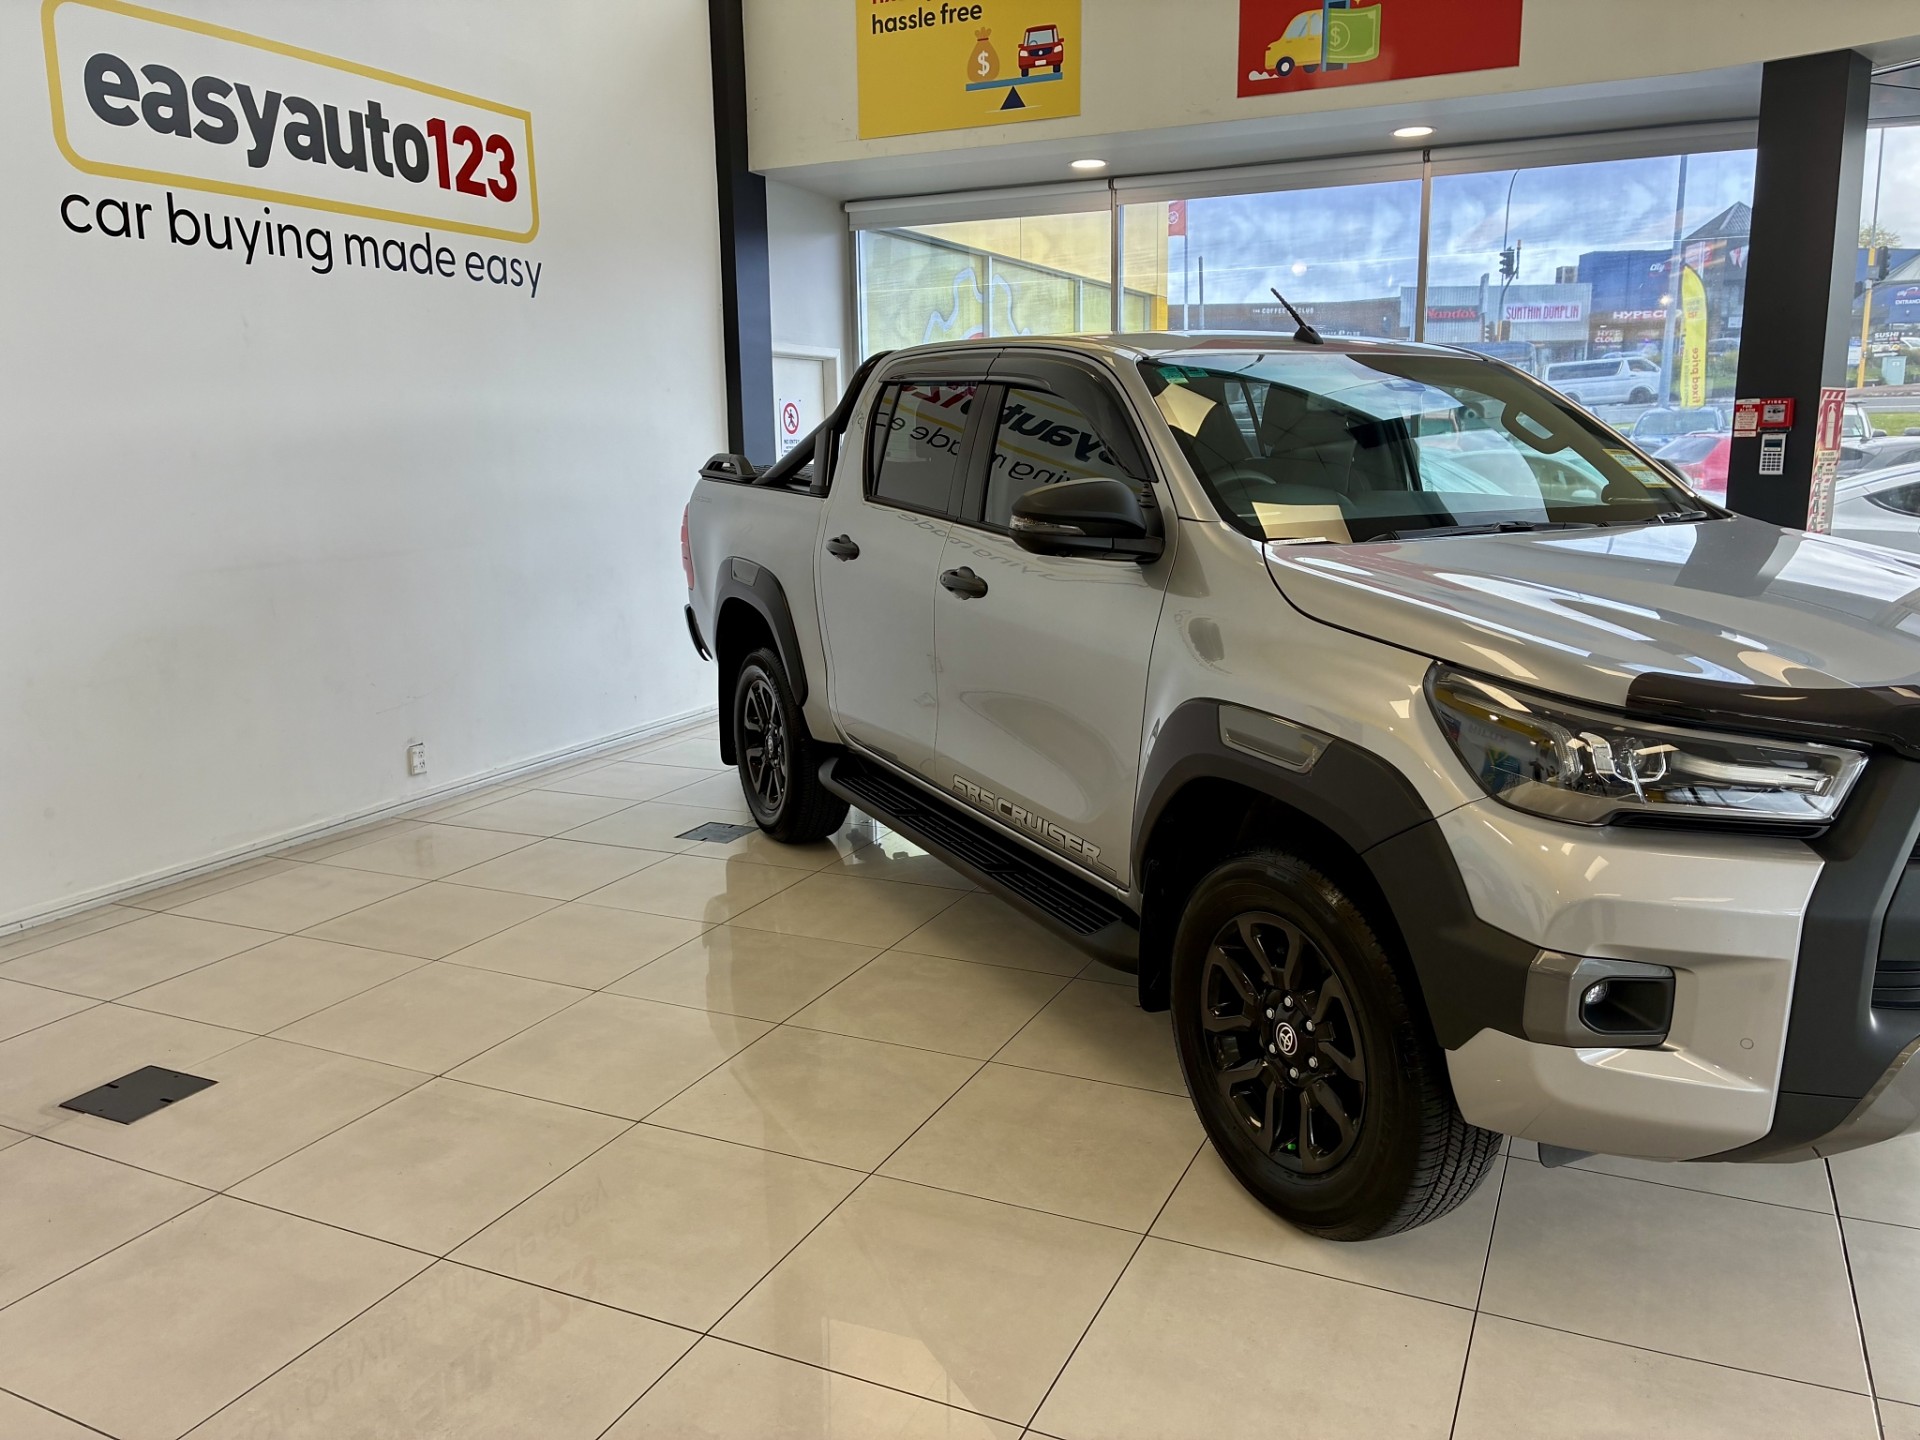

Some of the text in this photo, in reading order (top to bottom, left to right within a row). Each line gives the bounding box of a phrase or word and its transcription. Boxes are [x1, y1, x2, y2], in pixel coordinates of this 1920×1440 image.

[871, 3, 983, 34] hassle free
[83, 52, 518, 203] easyauto123
[60, 192, 543, 298] car buying made easy
[997, 797, 1103, 866] CRUISER
